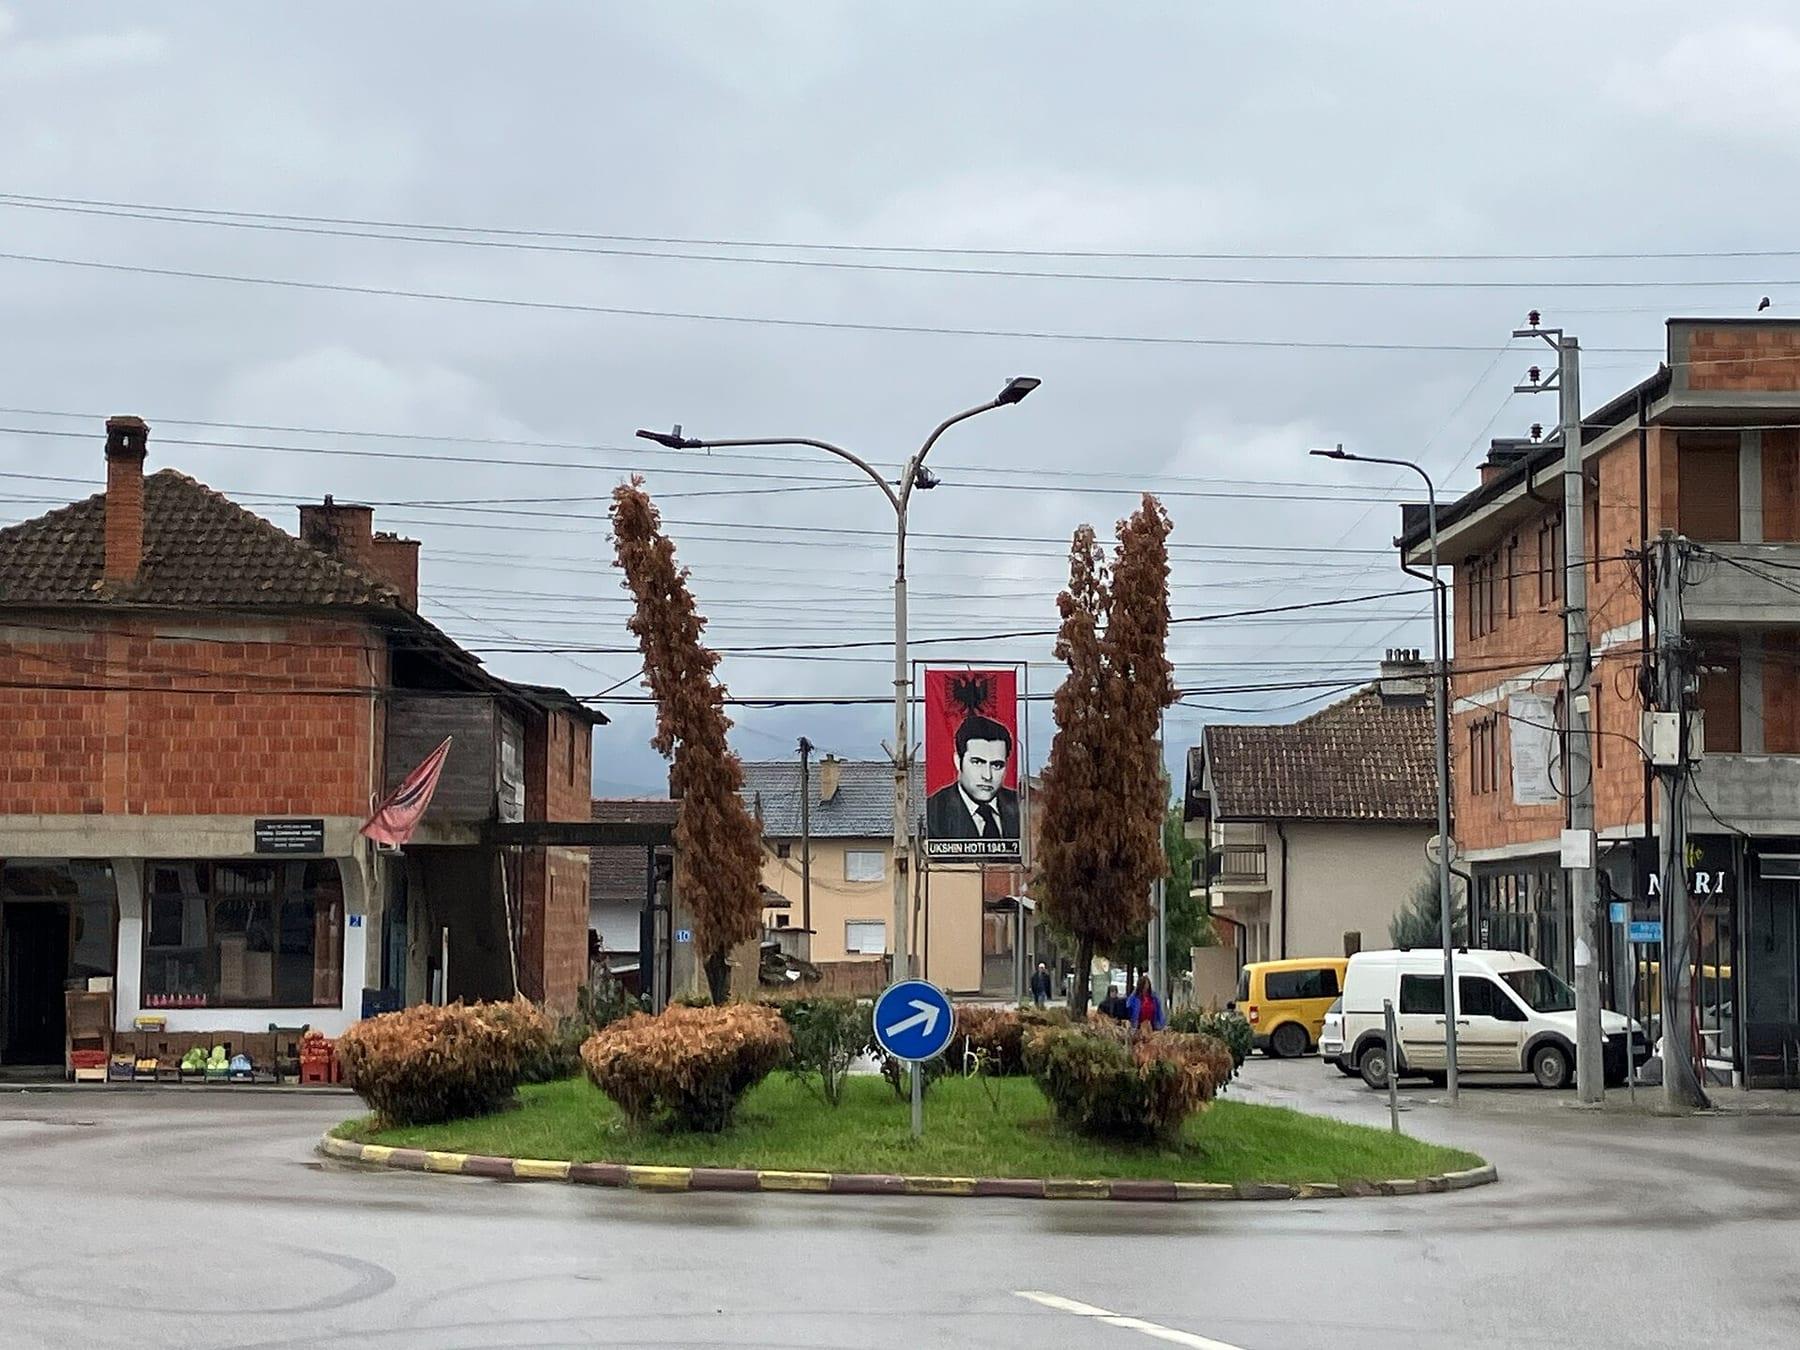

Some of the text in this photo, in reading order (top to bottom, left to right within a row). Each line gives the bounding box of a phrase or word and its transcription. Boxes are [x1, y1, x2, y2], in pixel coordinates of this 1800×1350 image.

[929, 843, 963, 853] UKSHIN
[964, 842, 985, 853] HOTI
[1647, 871, 1725, 895] NRI
